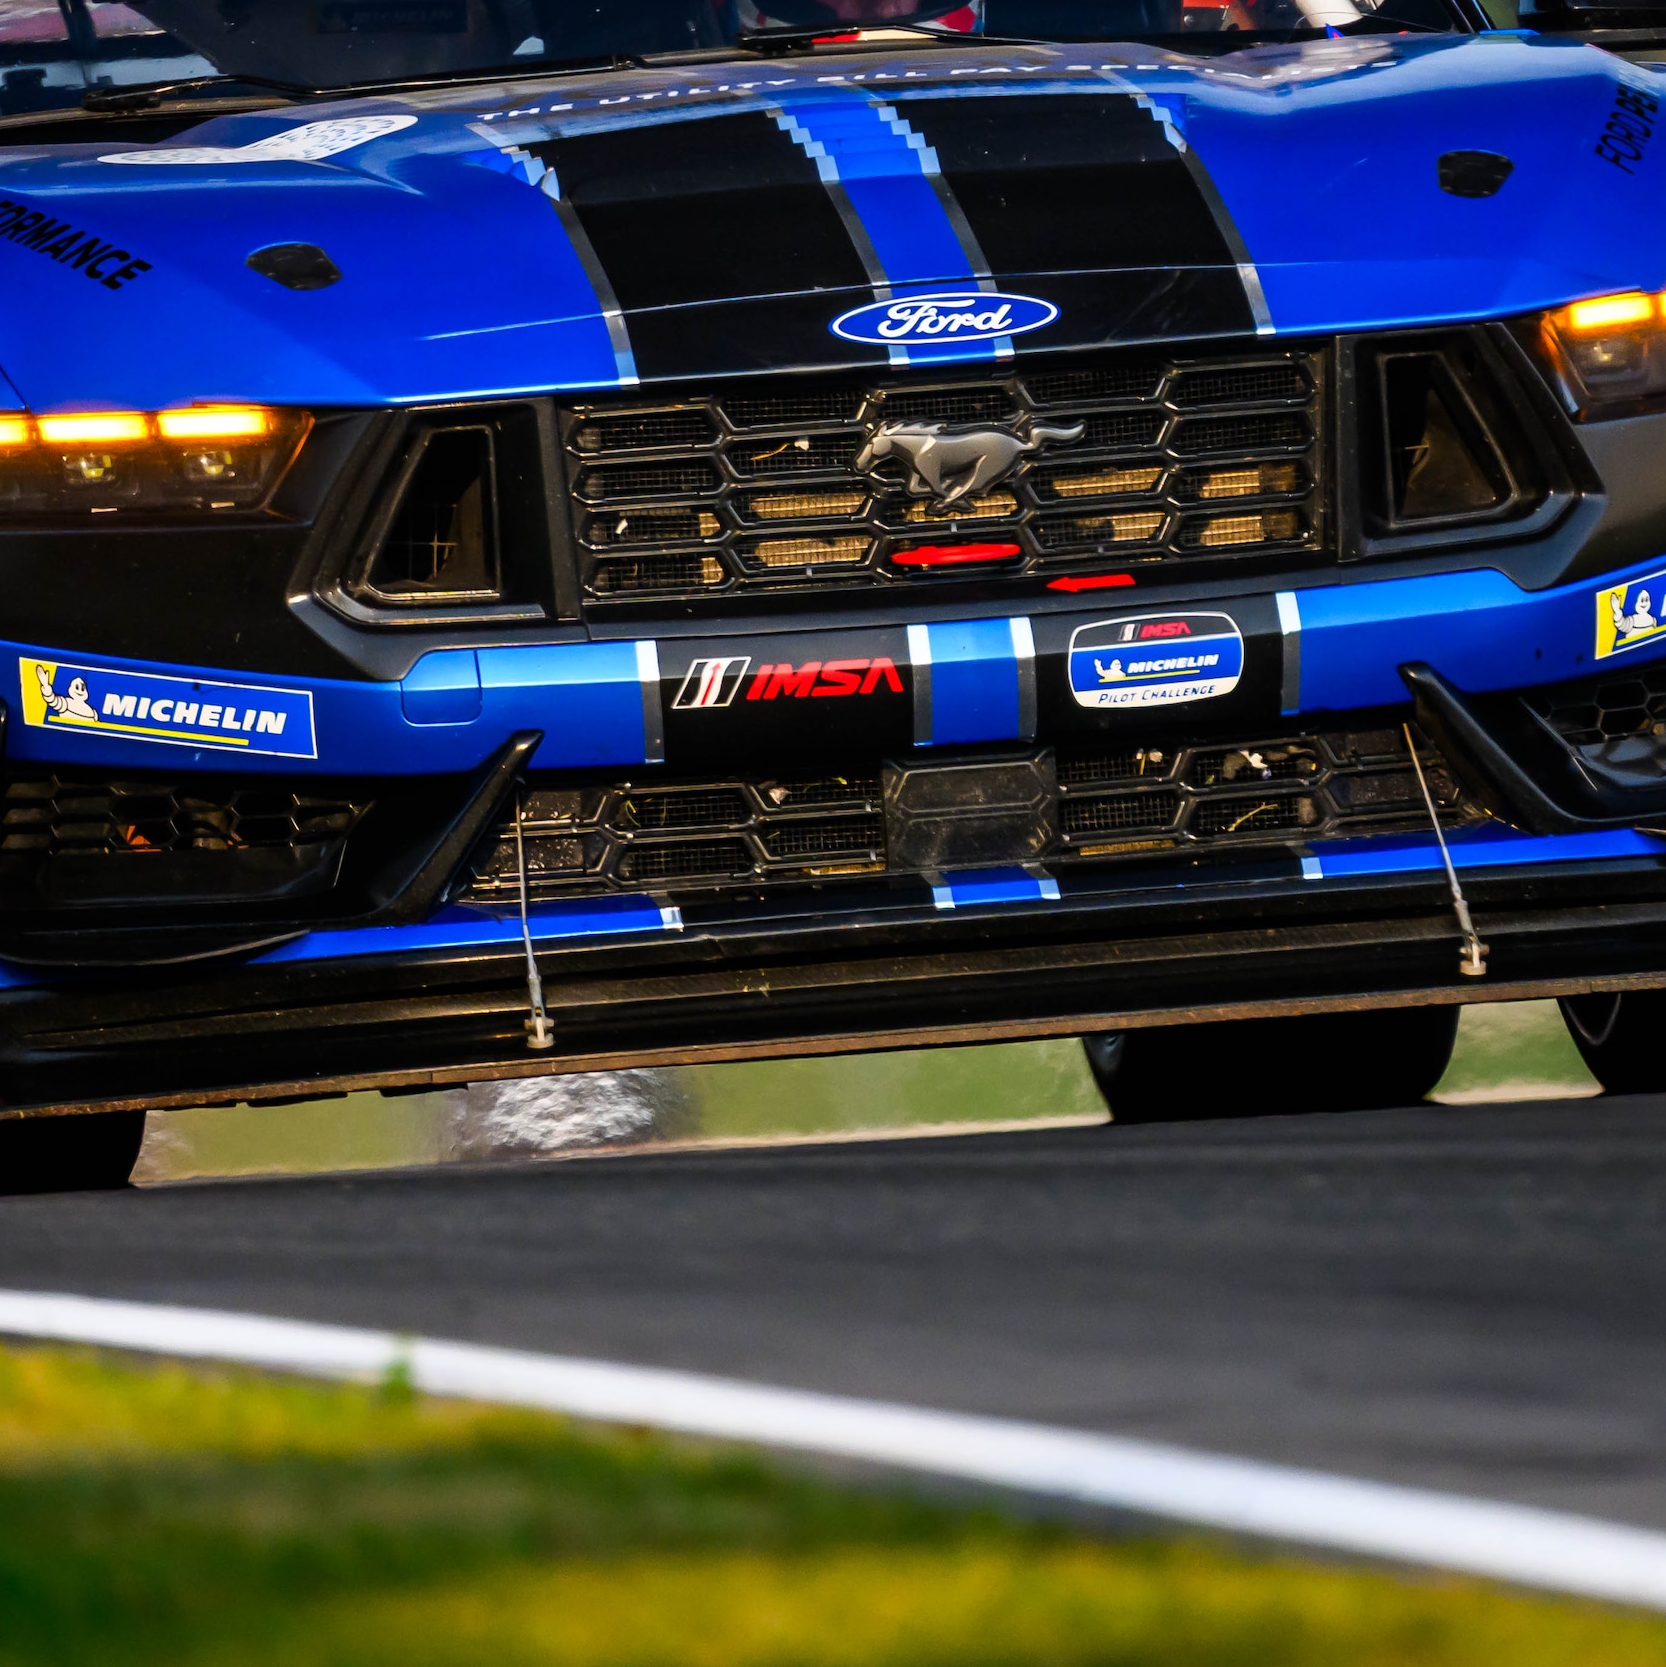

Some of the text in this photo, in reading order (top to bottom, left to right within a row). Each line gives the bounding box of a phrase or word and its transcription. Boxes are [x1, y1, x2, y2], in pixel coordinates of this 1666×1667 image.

[877, 298, 1014, 338] Ford
[1141, 621, 1192, 640] IMSA
[745, 656, 905, 701] IMSA
[1127, 653, 1220, 675] MICHELIN
[1097, 684, 1217, 705] PILOT CHALLENGE
[100, 691, 289, 736] MICHELIN
